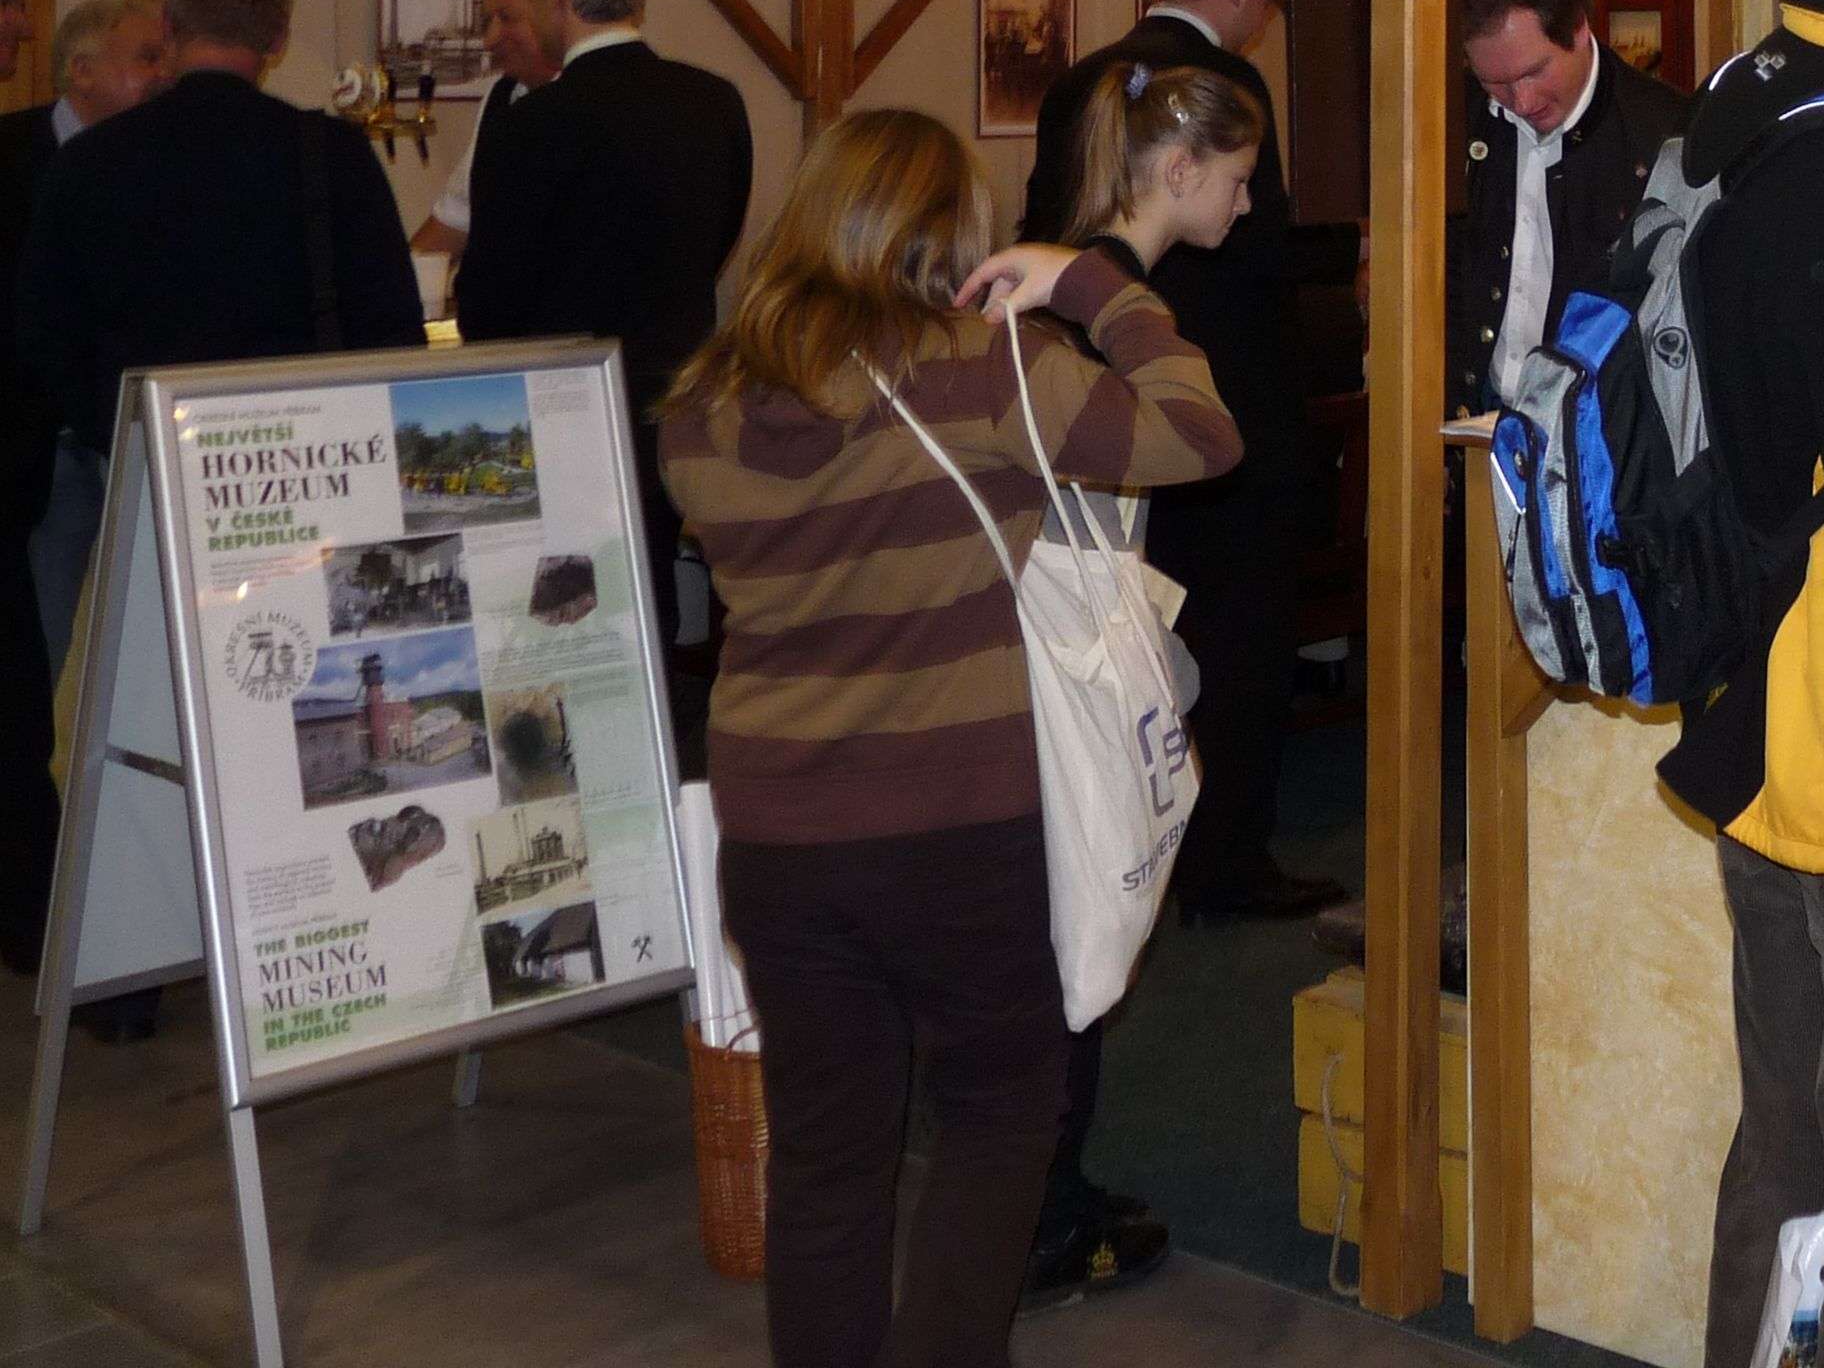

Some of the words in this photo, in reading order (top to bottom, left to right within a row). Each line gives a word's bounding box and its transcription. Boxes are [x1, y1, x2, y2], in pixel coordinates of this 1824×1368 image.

[198, 421, 293, 448] NEJVĚTŠÍ
[202, 434, 387, 480] HORNICKÉ
[206, 473, 350, 512] MUZEUM
[231, 507, 294, 530] ČESKÉ
[208, 526, 319, 552] REPUBLICE
[255, 939, 287, 957] THE
[295, 919, 370, 949] BIGGEST
[260, 941, 369, 986] MINING
[263, 964, 387, 1016] MUSEUM
[264, 1017, 285, 1035] IN
[292, 1007, 324, 1028] THE
[332, 992, 387, 1019] CZECH
[265, 1019, 351, 1052] REPUBLIC
